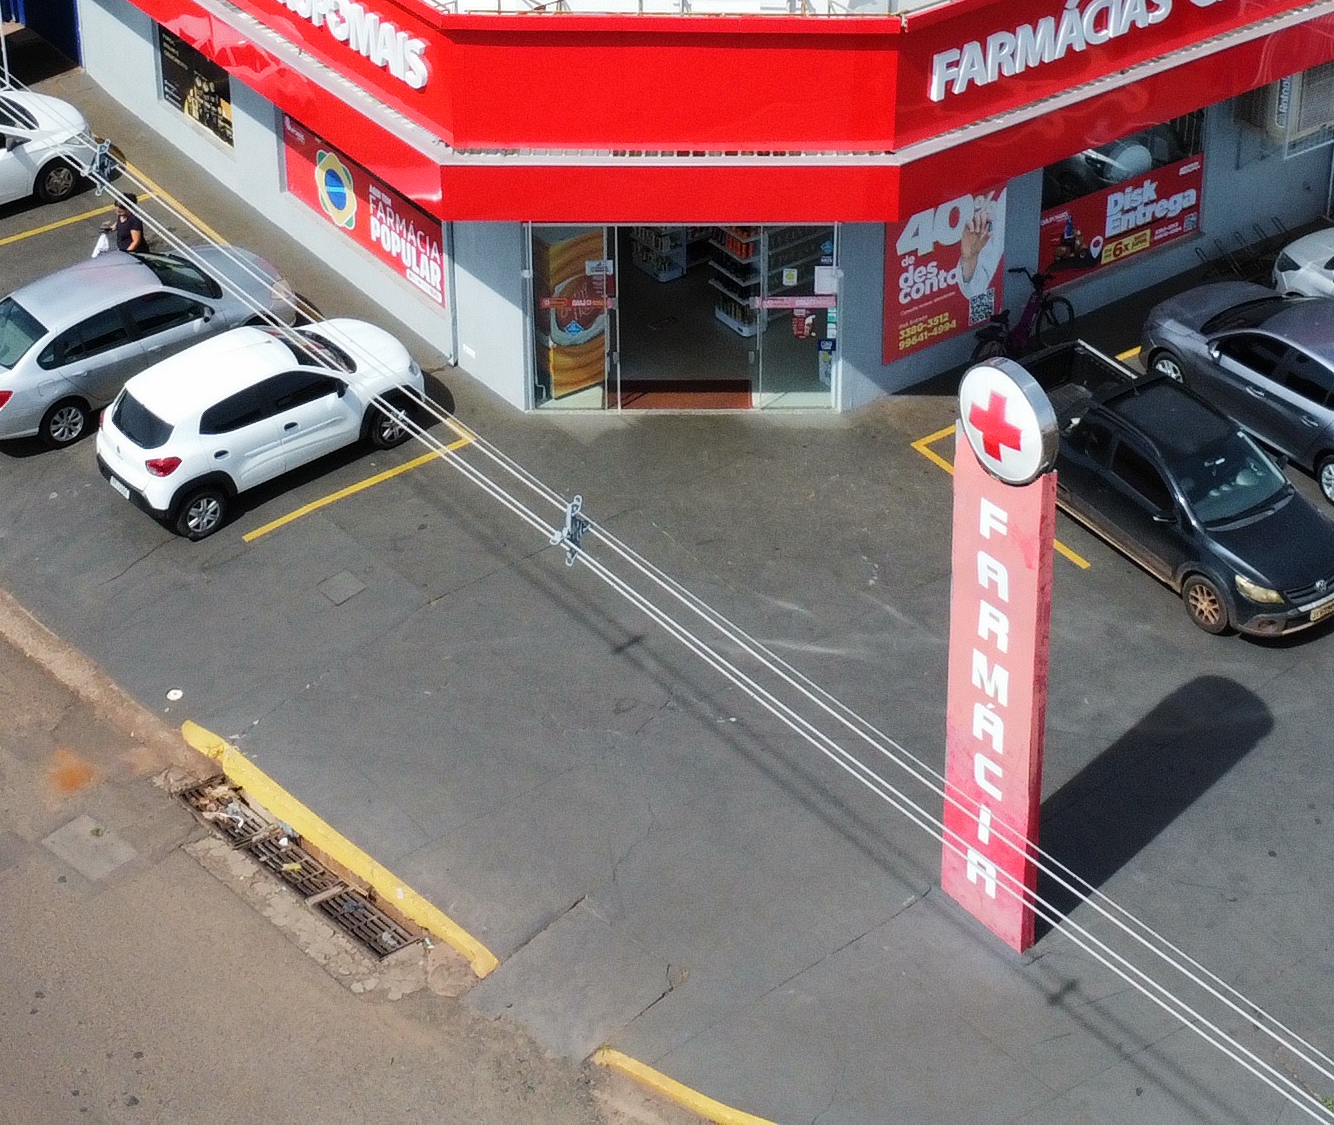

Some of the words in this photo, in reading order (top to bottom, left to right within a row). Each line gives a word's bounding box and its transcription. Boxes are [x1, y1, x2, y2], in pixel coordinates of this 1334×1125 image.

[1105, 188, 1197, 238] Entrega
[1107, 179, 1158, 215] Disk
[369, 194, 441, 264] FARMÁCIA
[370, 215, 442, 292] POPULAR
[901, 255, 915, 267] de
[1113, 241, 1129, 257] 6x
[898, 268, 958, 304] conto
[899, 261, 938, 288] des
[967, 496, 1008, 900] FARMÁCIA
